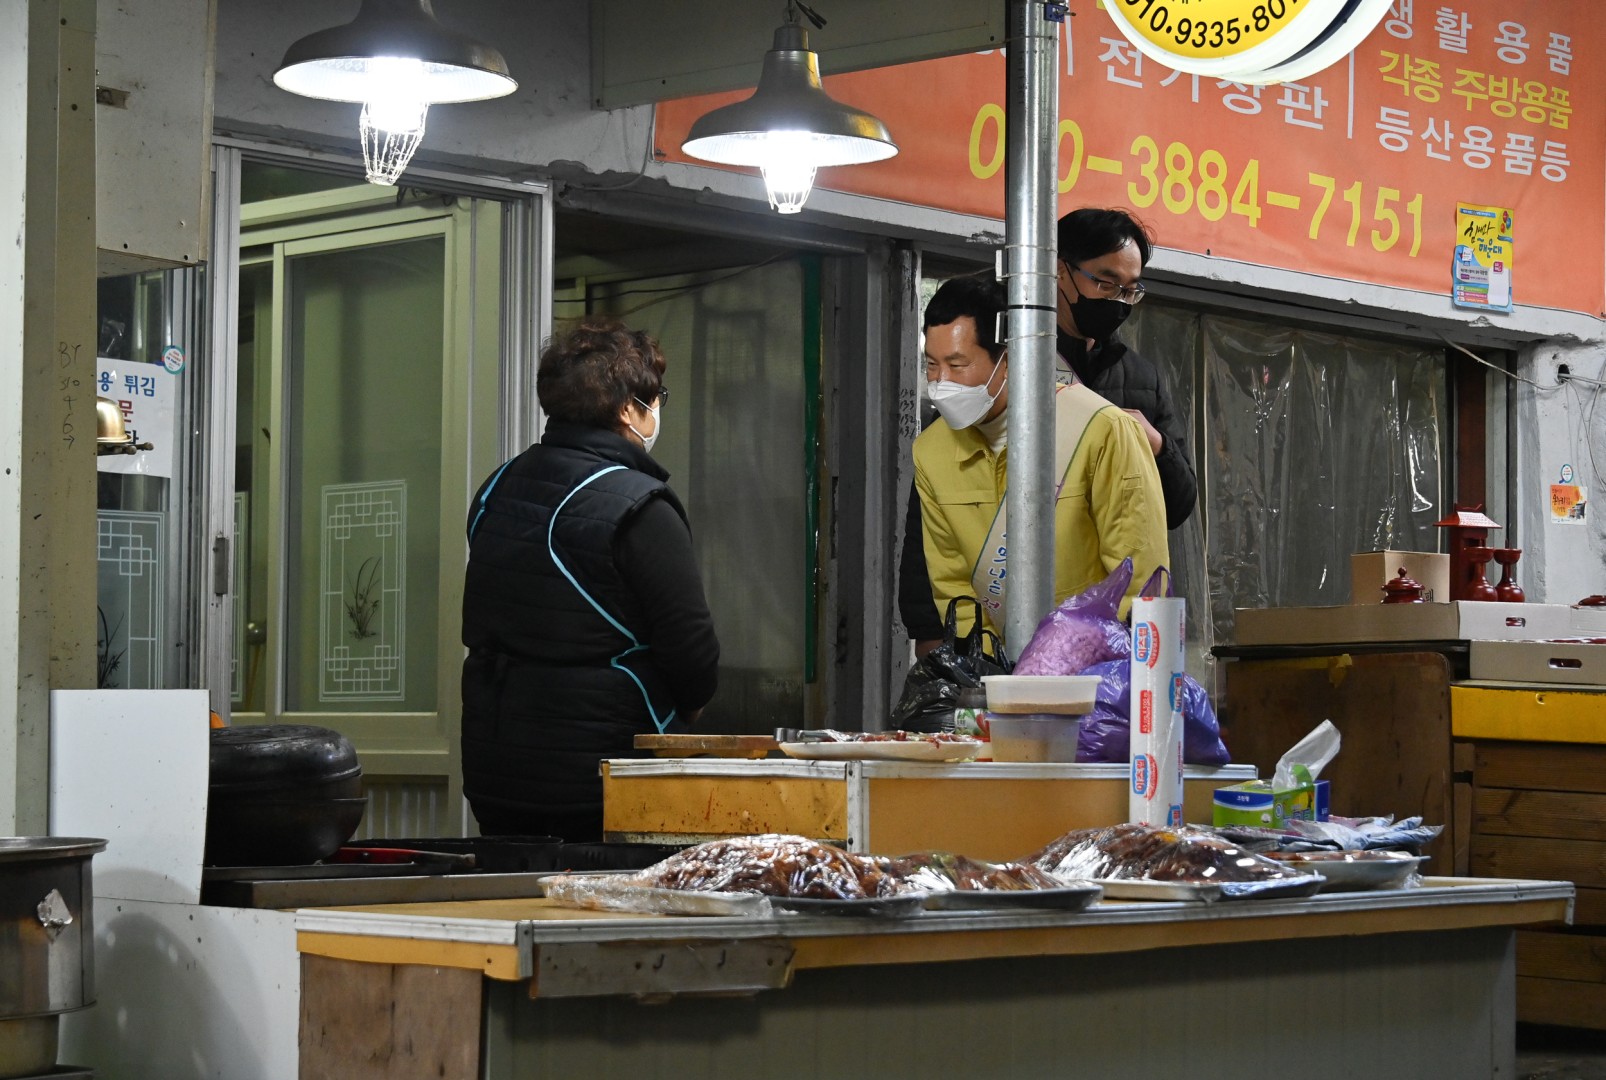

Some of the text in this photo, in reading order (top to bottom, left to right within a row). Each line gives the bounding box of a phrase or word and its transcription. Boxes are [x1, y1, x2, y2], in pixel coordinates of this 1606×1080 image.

[1379, 50, 1573, 129] 각종 주방용품
[968, 103, 1424, 258] 00-3884-7151
[124, 374, 156, 397] 튀김
